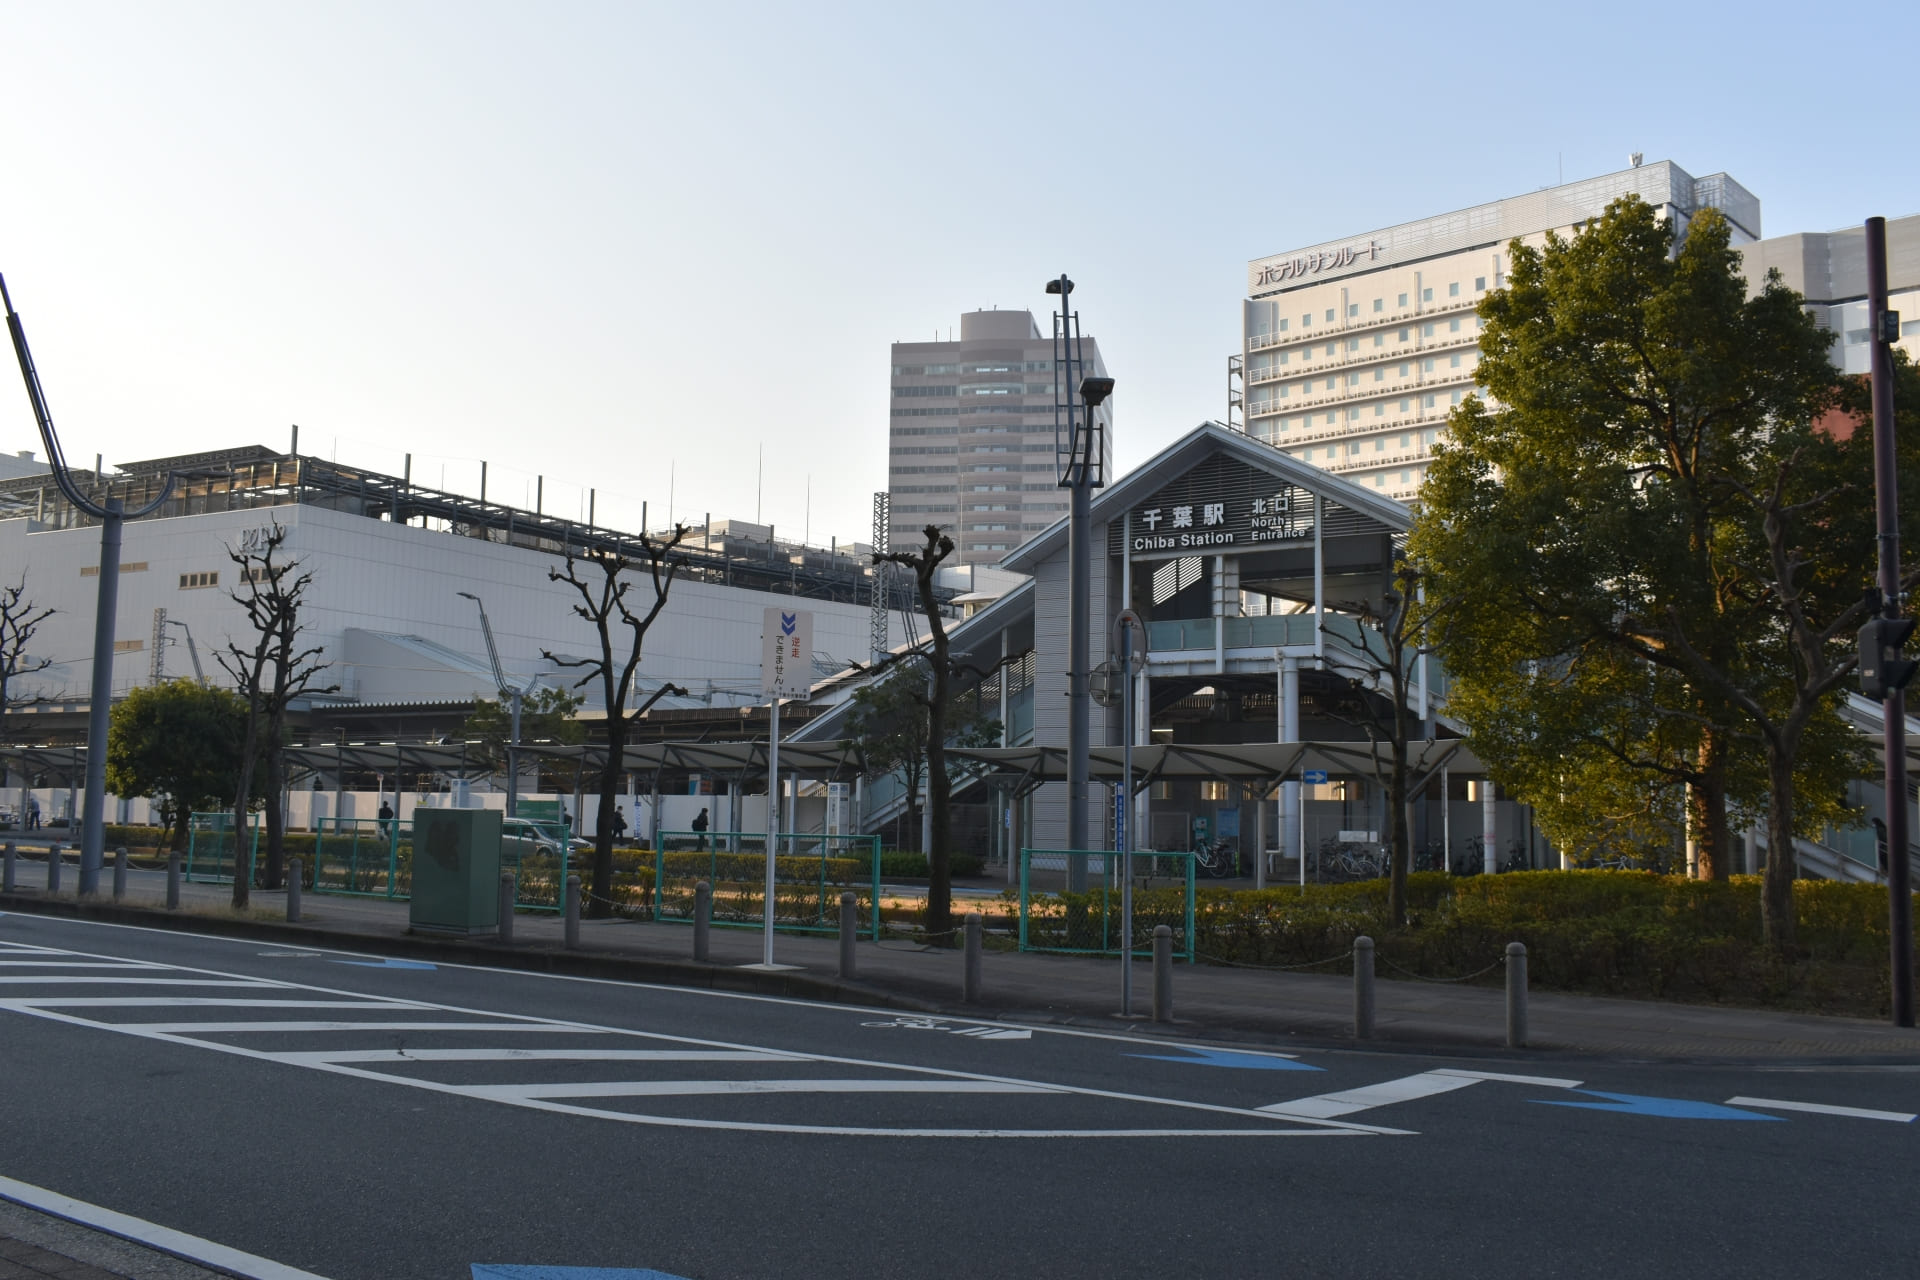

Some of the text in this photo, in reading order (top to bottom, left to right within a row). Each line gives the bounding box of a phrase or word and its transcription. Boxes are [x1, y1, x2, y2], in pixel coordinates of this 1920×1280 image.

[1256, 240, 1382, 286] ホテルサンルート
[1252, 496, 1289, 514] 北口
[1142, 502, 1225, 531] 千葉駅
[1251, 515, 1286, 528] North
[1134, 531, 1234, 550] Chiba Station
[1251, 528, 1306, 541] Entrance
[791, 637, 800, 658] 逆走
[775, 635, 784, 685] できません
